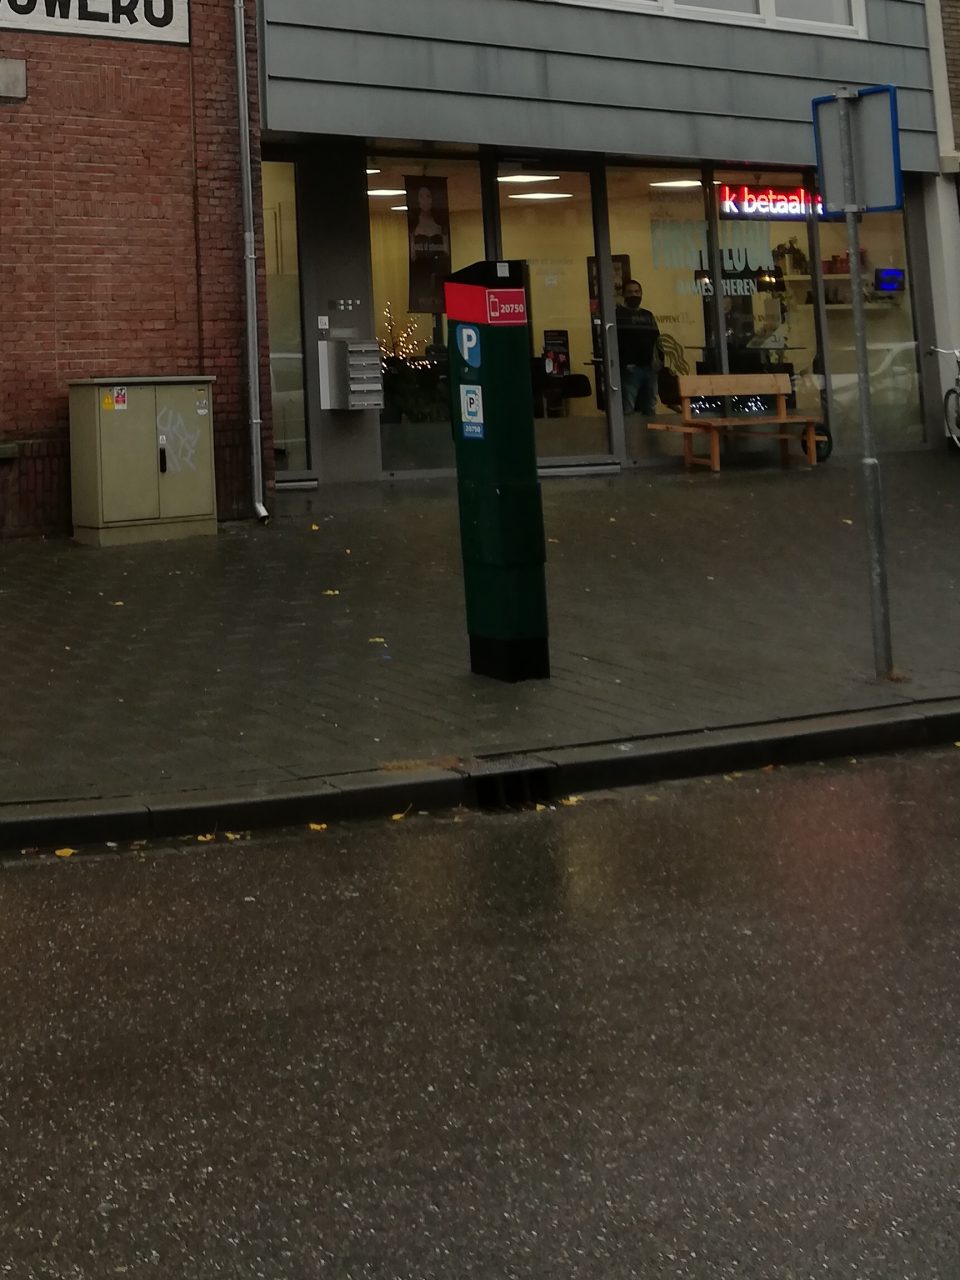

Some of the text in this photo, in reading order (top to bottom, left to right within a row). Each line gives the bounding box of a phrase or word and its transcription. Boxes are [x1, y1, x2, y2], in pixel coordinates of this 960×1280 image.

[743, 186, 806, 215] betaal
[500, 304, 524, 314] 20750
[462, 328, 477, 361] P
